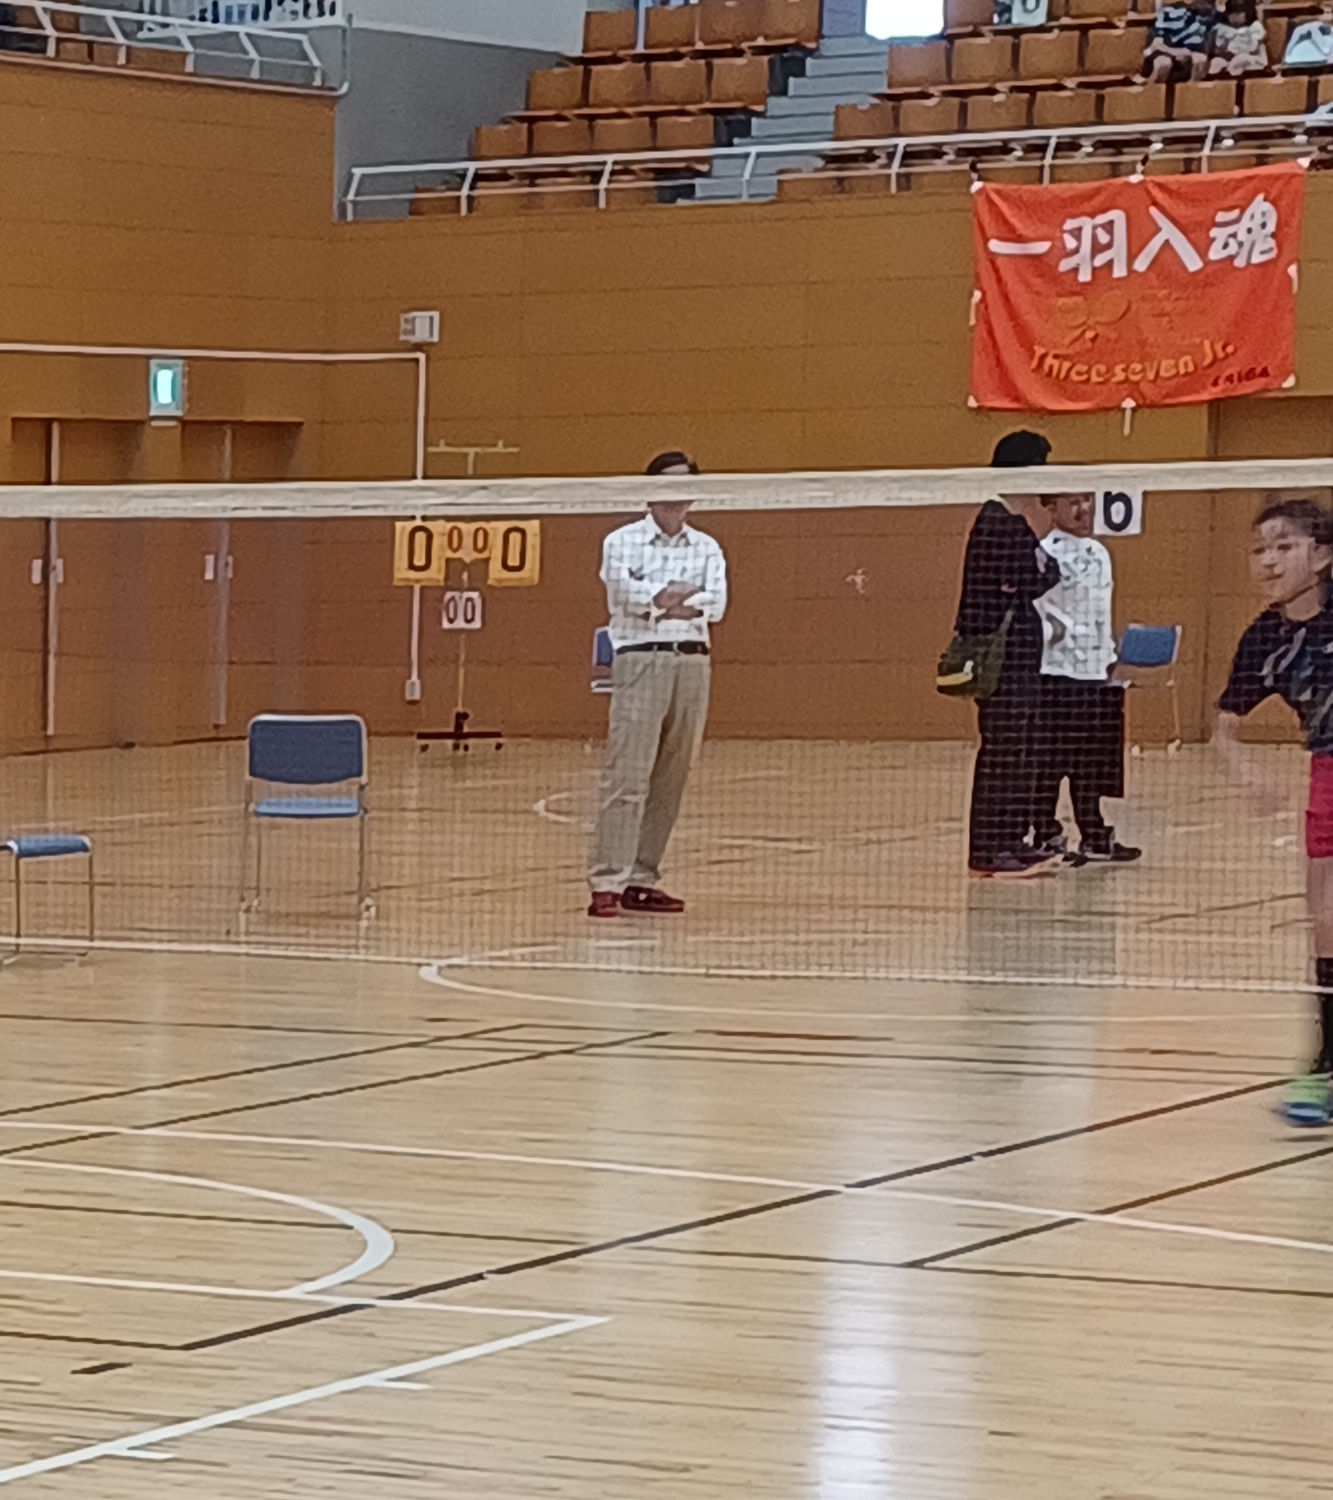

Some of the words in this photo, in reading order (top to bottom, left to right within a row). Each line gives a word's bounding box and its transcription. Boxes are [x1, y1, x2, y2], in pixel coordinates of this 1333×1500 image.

[988, 193, 1278, 282] 一羽入魂
[407, 525, 434, 572] 0
[501, 526, 527, 572] 0
